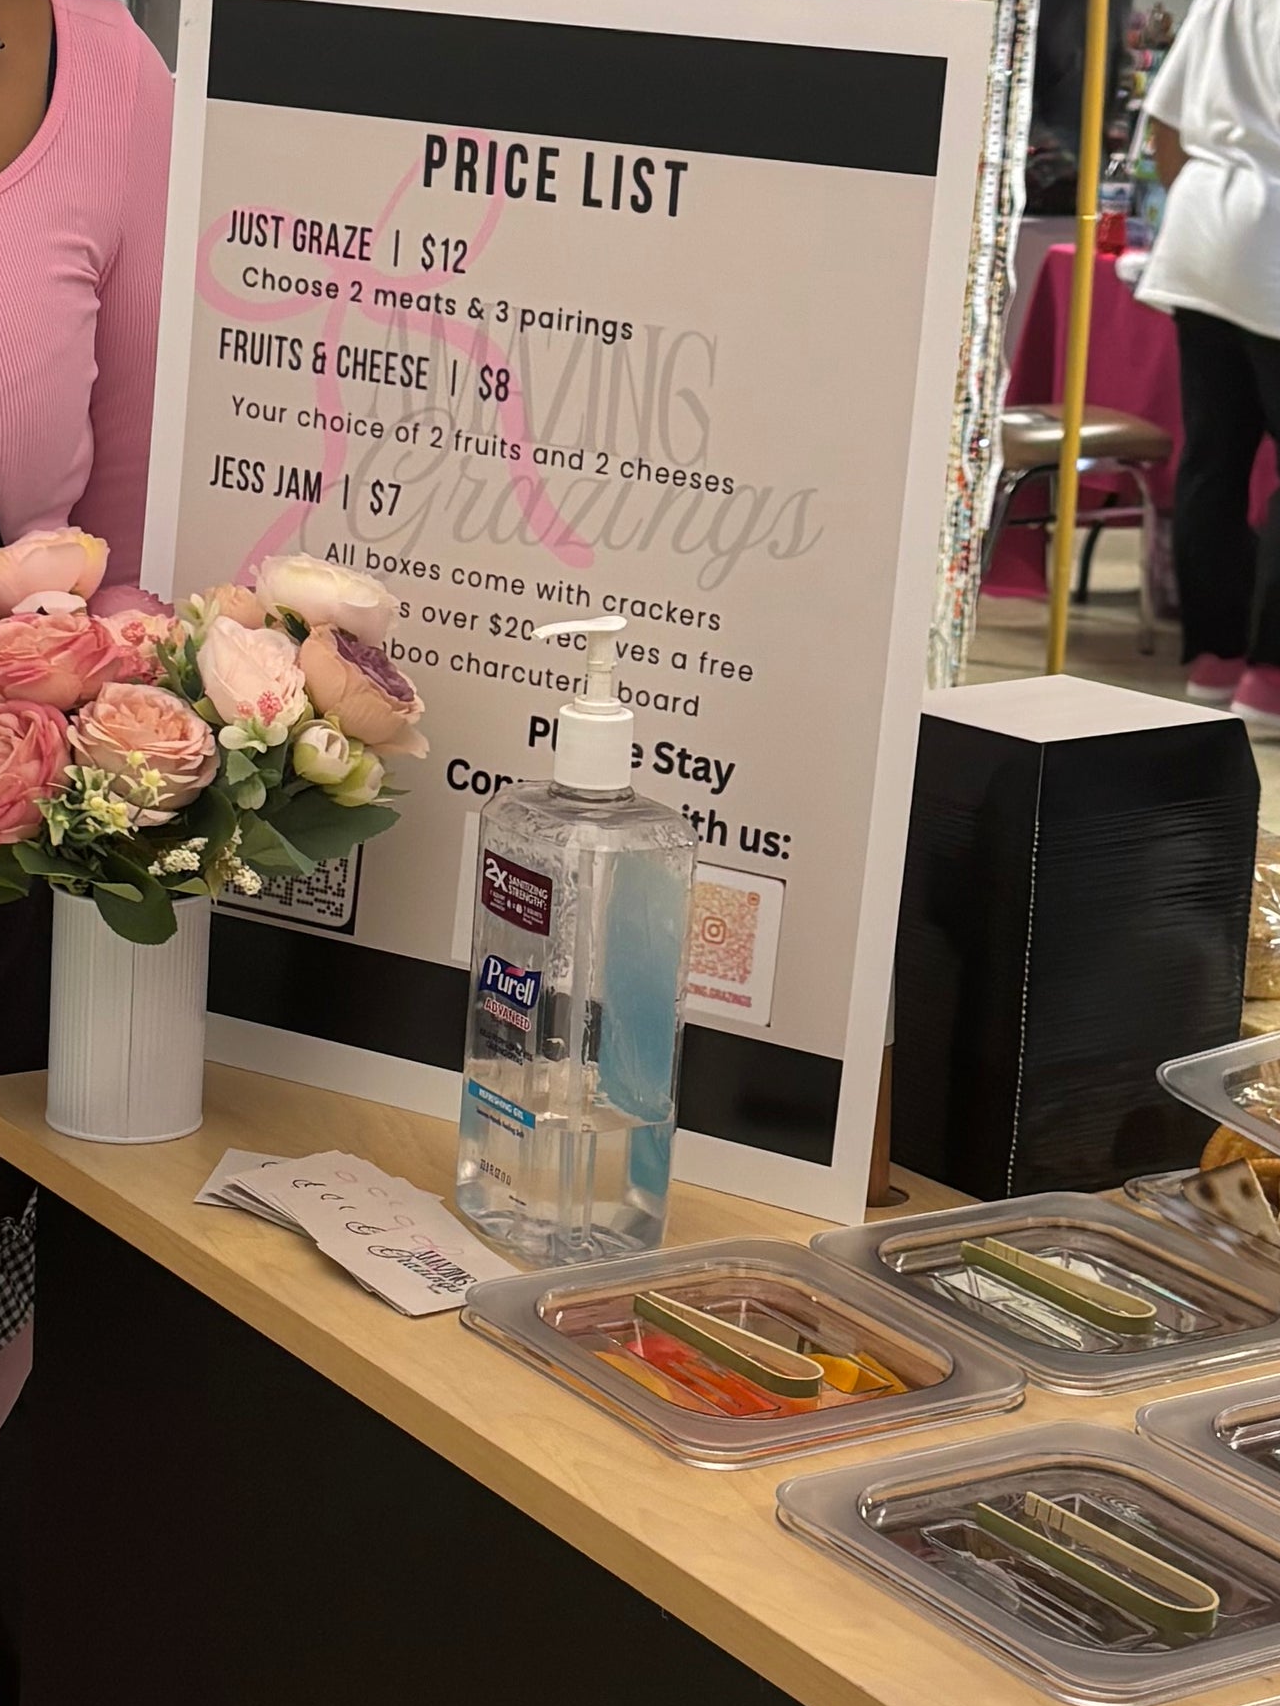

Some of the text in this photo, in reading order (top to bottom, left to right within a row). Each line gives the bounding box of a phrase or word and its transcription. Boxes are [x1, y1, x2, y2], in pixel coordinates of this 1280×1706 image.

[423, 133, 689, 217] PRICE LIST
[226, 210, 285, 249] JUST
[292, 218, 373, 261] GRAZE
[421, 233, 468, 274] $12
[242, 266, 634, 344] Choose 2 meats & 3 pairings
[219, 327, 303, 371] FRUITS
[312, 341, 327, 375] &
[336, 344, 430, 391] CHEESE
[478, 364, 510, 402] $8
[231, 394, 735, 495] Your choice of 2 fruits and 2 cheeses
[210, 454, 265, 494] JESS
[273, 465, 322, 503] JAM
[370, 479, 402, 516] $7
[325, 542, 721, 631] All boxes come with crackers
[422, 606, 479, 630] over
[489, 613, 535, 641] $20
[544, 631, 661, 664] ecves
[671, 651, 687, 670] a
[699, 651, 754, 682] free
[450, 652, 588, 694] charcuteri
[617, 681, 700, 717] board
[652, 741, 736, 794] Stay
[681, 804, 792, 859] ith us:
[485, 858, 509, 893] 2X
[486, 956, 536, 1006] Purell
